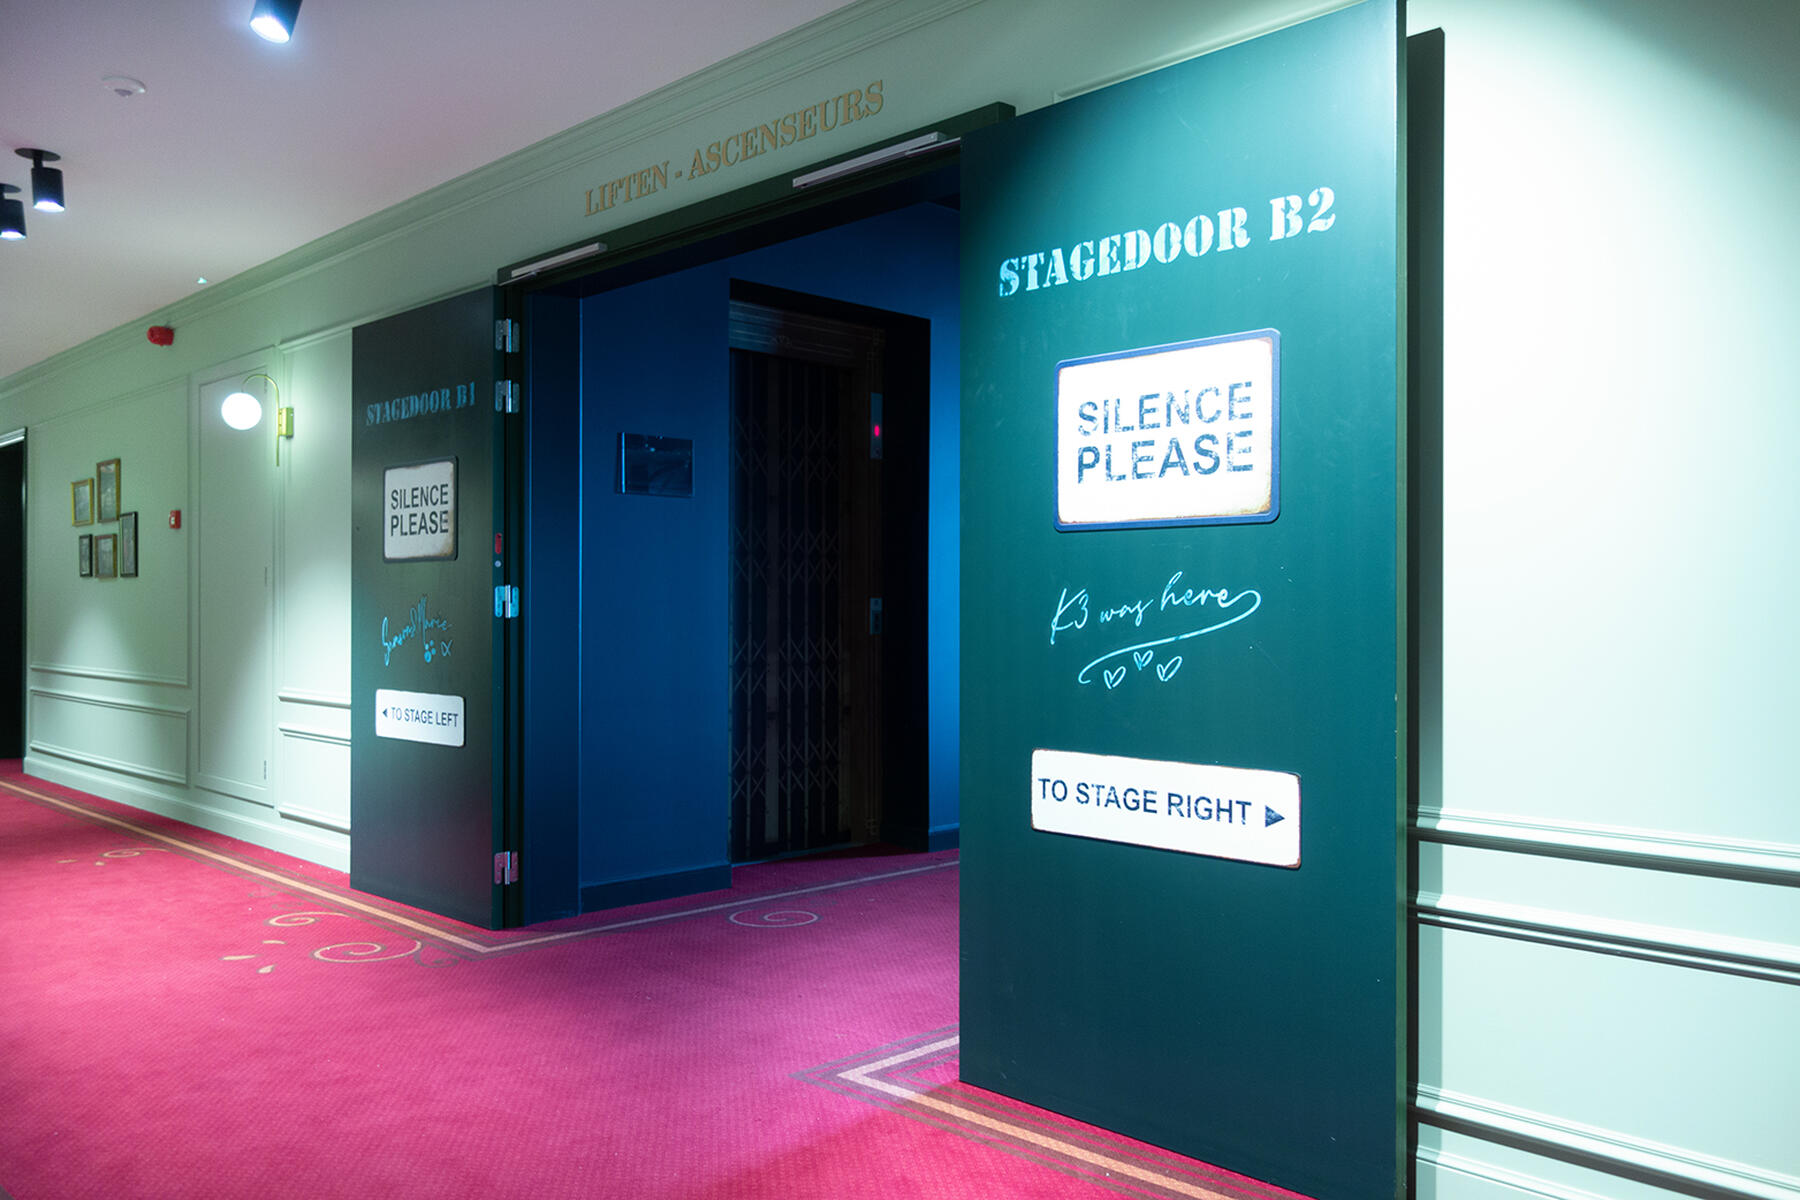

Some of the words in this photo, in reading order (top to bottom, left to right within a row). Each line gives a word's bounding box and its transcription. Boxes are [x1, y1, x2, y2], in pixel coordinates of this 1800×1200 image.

[584, 160, 670, 217] LIFTEN
[687, 79, 885, 181] ASCENSEURS
[998, 206, 1251, 297] STAGEDOOR
[1268, 186, 1336, 241] B2
[365, 387, 451, 426] STAGEDOOR
[456, 381, 475, 409] B1
[1077, 380, 1253, 437] SILENCE
[1077, 430, 1254, 484] PLEASE
[390, 483, 449, 510] SILENCE
[390, 510, 449, 537] PLEASE
[1050, 587, 1089, 646] K3
[1160, 570, 1254, 614] here
[390, 706, 403, 721] TO
[404, 709, 434, 725] STAGE
[435, 712, 459, 728] LEFT
[1037, 777, 1069, 802] TO
[1075, 781, 1158, 814] STAGE
[1166, 792, 1252, 826] RIGHT
